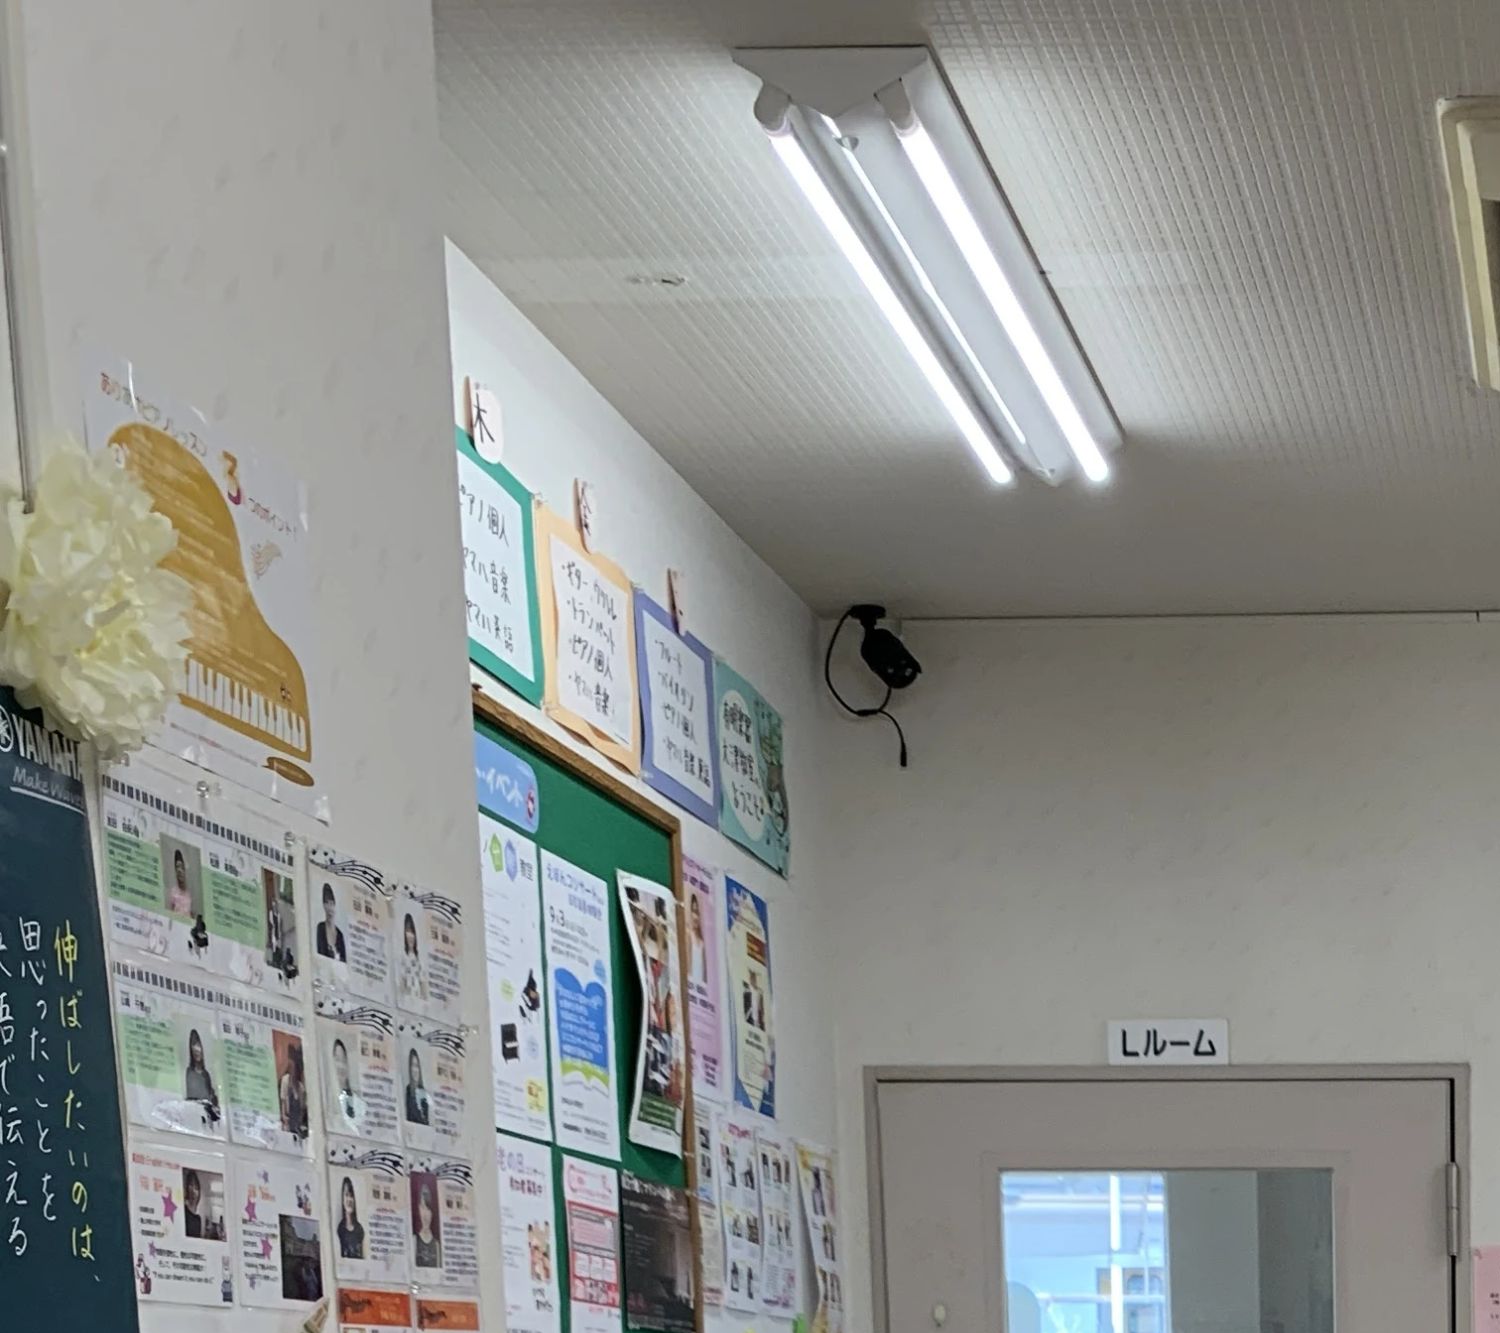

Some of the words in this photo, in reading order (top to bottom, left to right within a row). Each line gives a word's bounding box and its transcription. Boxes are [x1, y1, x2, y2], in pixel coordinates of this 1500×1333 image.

[473, 392, 496, 444] 木
[12, 713, 83, 782] YAMAH
[13, 765, 51, 792] Make
[19, 915, 57, 1222] 思ったことを
[1121, 1028, 1217, 1057] Lルーム
